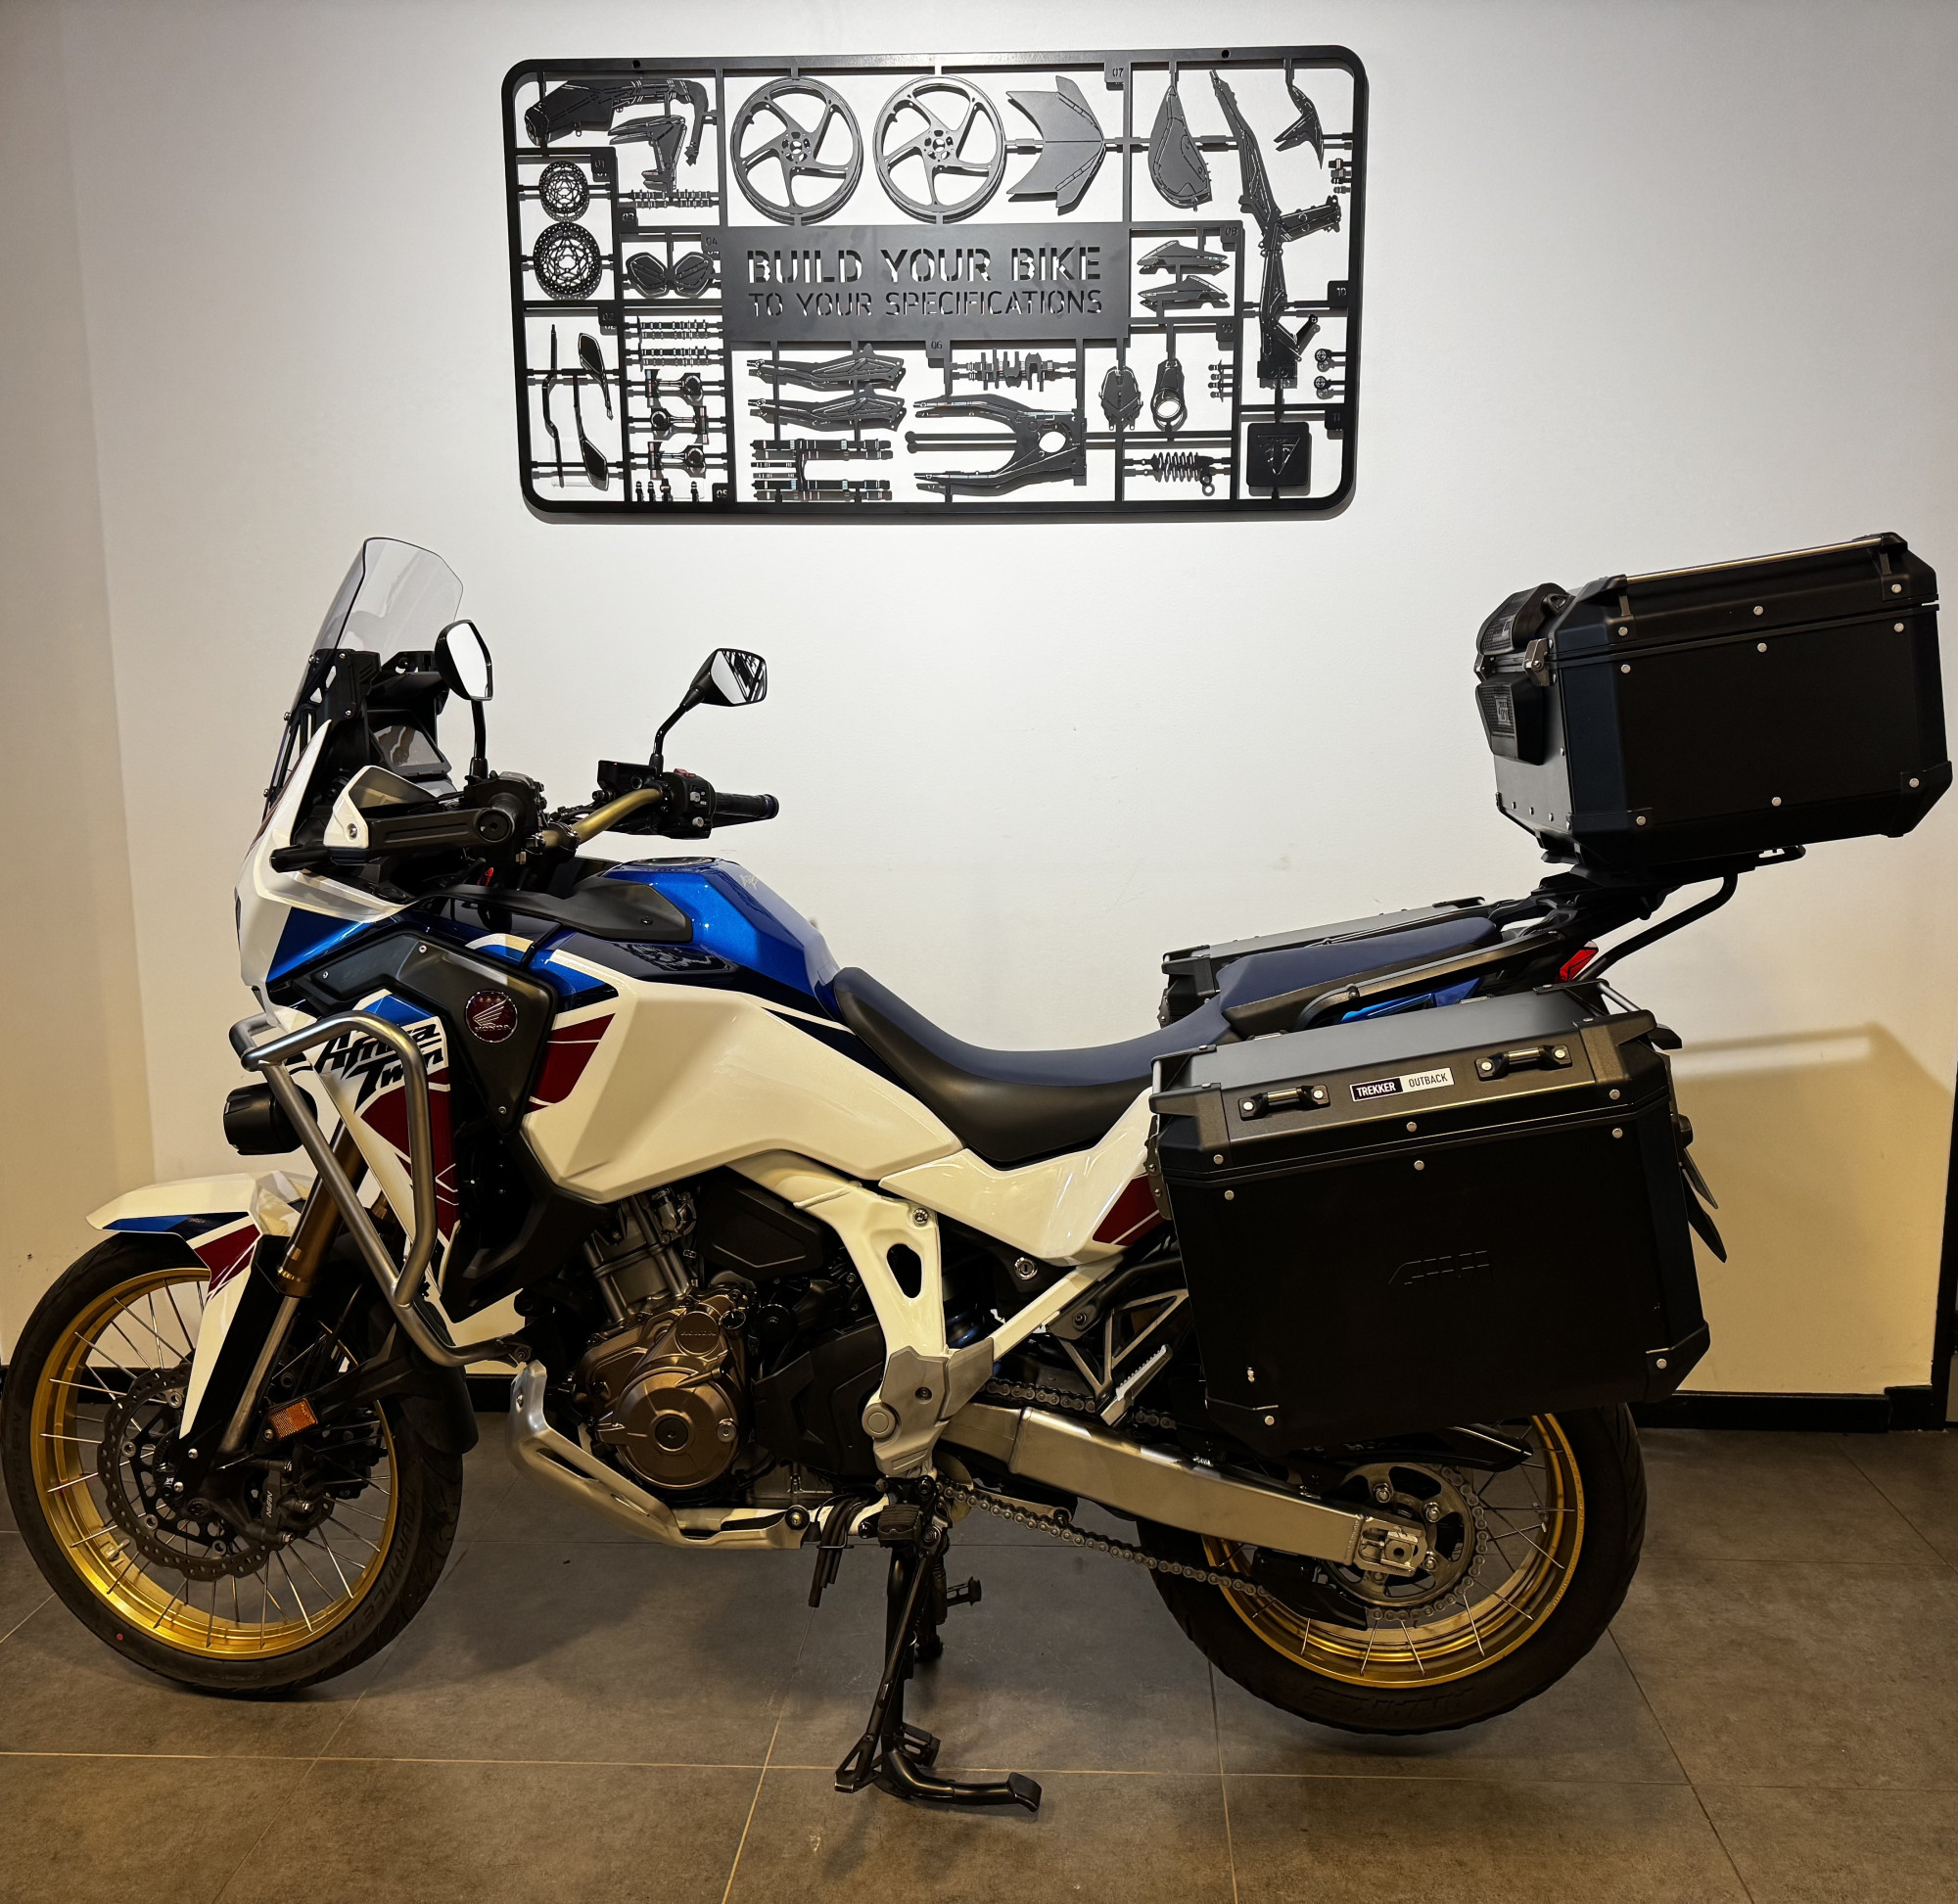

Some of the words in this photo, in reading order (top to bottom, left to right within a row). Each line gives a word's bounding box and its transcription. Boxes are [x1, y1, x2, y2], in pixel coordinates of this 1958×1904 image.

[1112, 68, 1124, 77] 07
[705, 237, 718, 247] 04
[747, 250, 862, 284] BUILD
[881, 248, 992, 283] YOUR
[1011, 247, 1100, 282] BIKE
[748, 293, 783, 317] TO
[796, 292, 872, 316] YOUR
[885, 290, 1102, 316] SPECIFICATIONS
[930, 341, 943, 349] 06
[1356, 1082, 1396, 1097] TREKKER
[1408, 1073, 1448, 1088] OUTBACK
